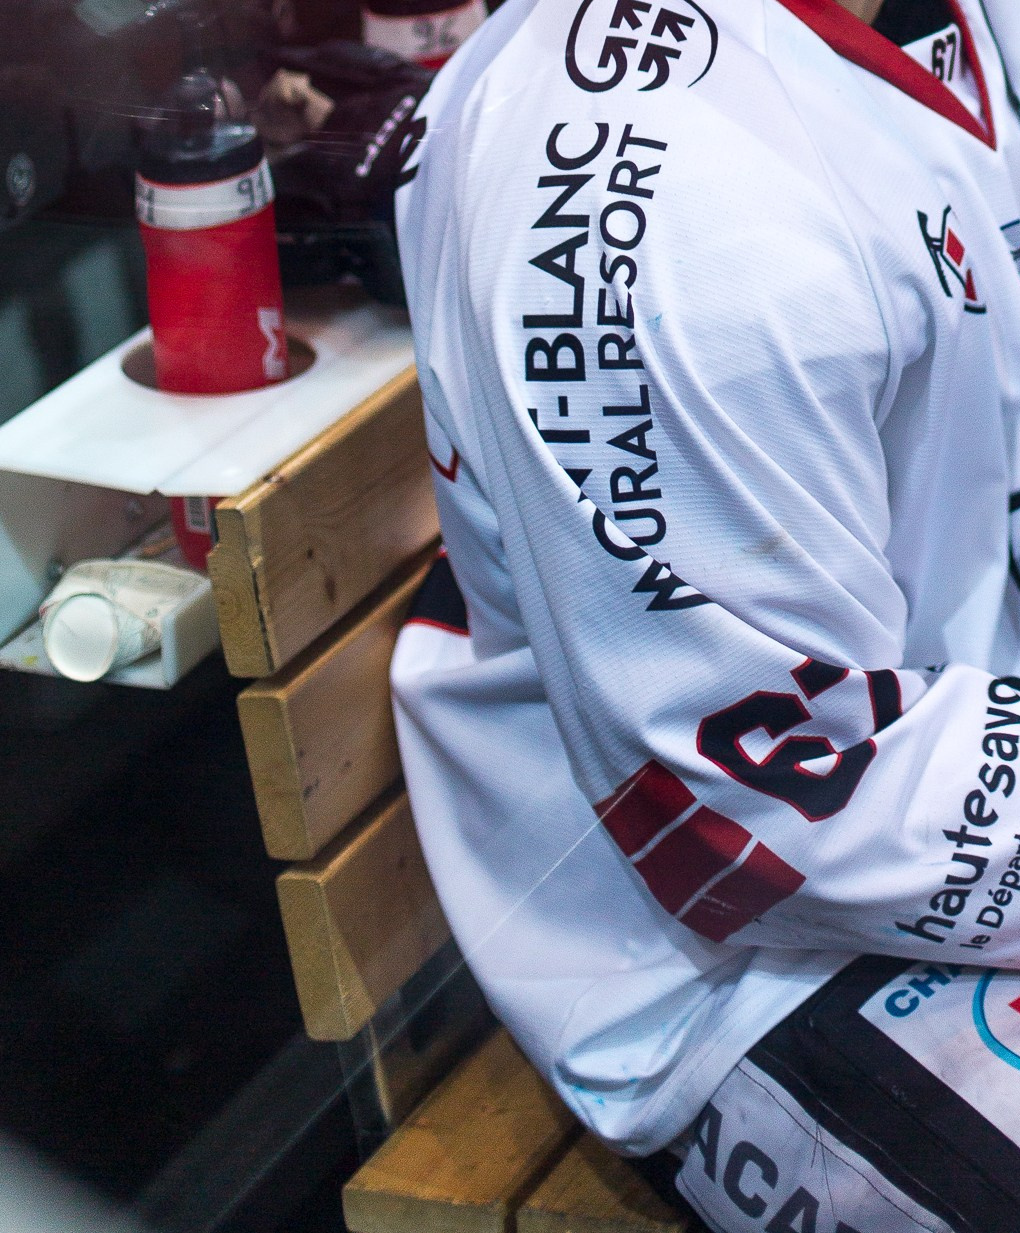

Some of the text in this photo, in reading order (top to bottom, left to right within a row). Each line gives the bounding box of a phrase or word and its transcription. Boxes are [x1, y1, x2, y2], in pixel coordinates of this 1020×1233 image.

[931, 31, 958, 82] 67
[596, 123, 668, 370] RESORT
[959, 934, 992, 950] le
